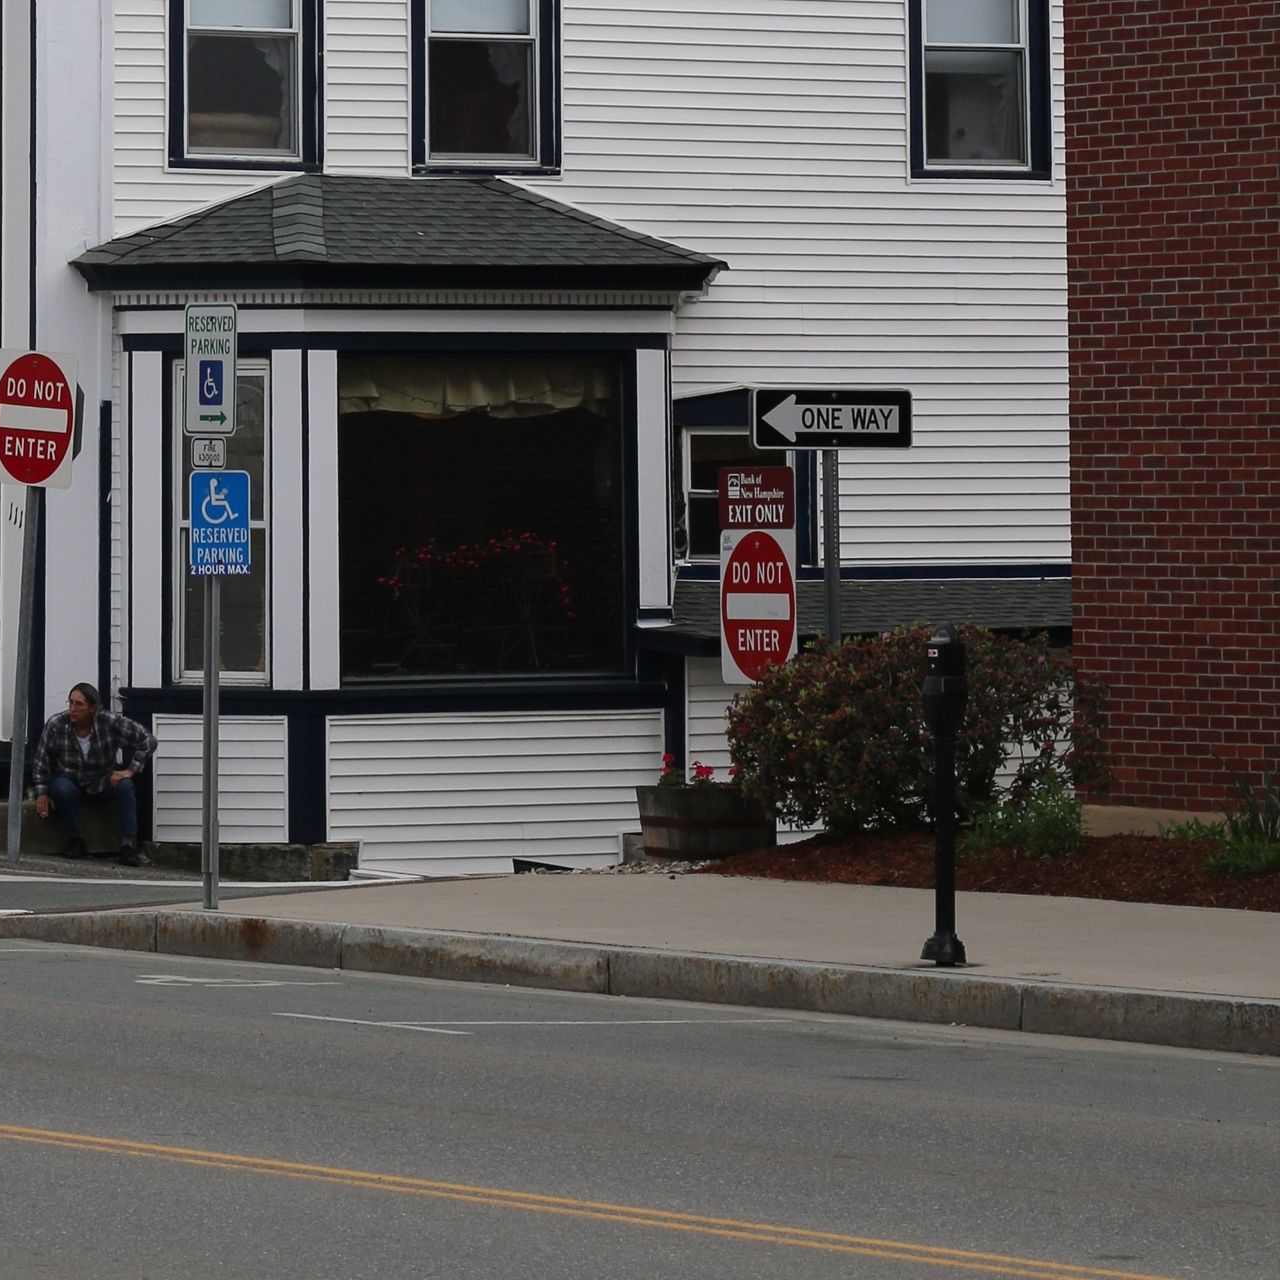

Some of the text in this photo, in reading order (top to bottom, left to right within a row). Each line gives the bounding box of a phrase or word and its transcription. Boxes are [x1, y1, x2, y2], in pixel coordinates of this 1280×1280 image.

[188, 316, 234, 332] RESERVED
[191, 338, 231, 355] PARKING
[7, 377, 64, 403] DO NOT
[801, 407, 893, 430] ONE WAY
[5, 435, 57, 461] ENTER
[740, 473, 762, 485] Bank of
[740, 487, 785, 501] New Hampshire
[728, 504, 785, 523] EXIT ONLY
[193, 527, 248, 544] RESERVED
[197, 547, 244, 563] PARKING
[190, 564, 251, 575] 2 HOUR MAX.
[732, 561, 784, 584] DO NOT
[738, 628, 780, 652] ENTER
